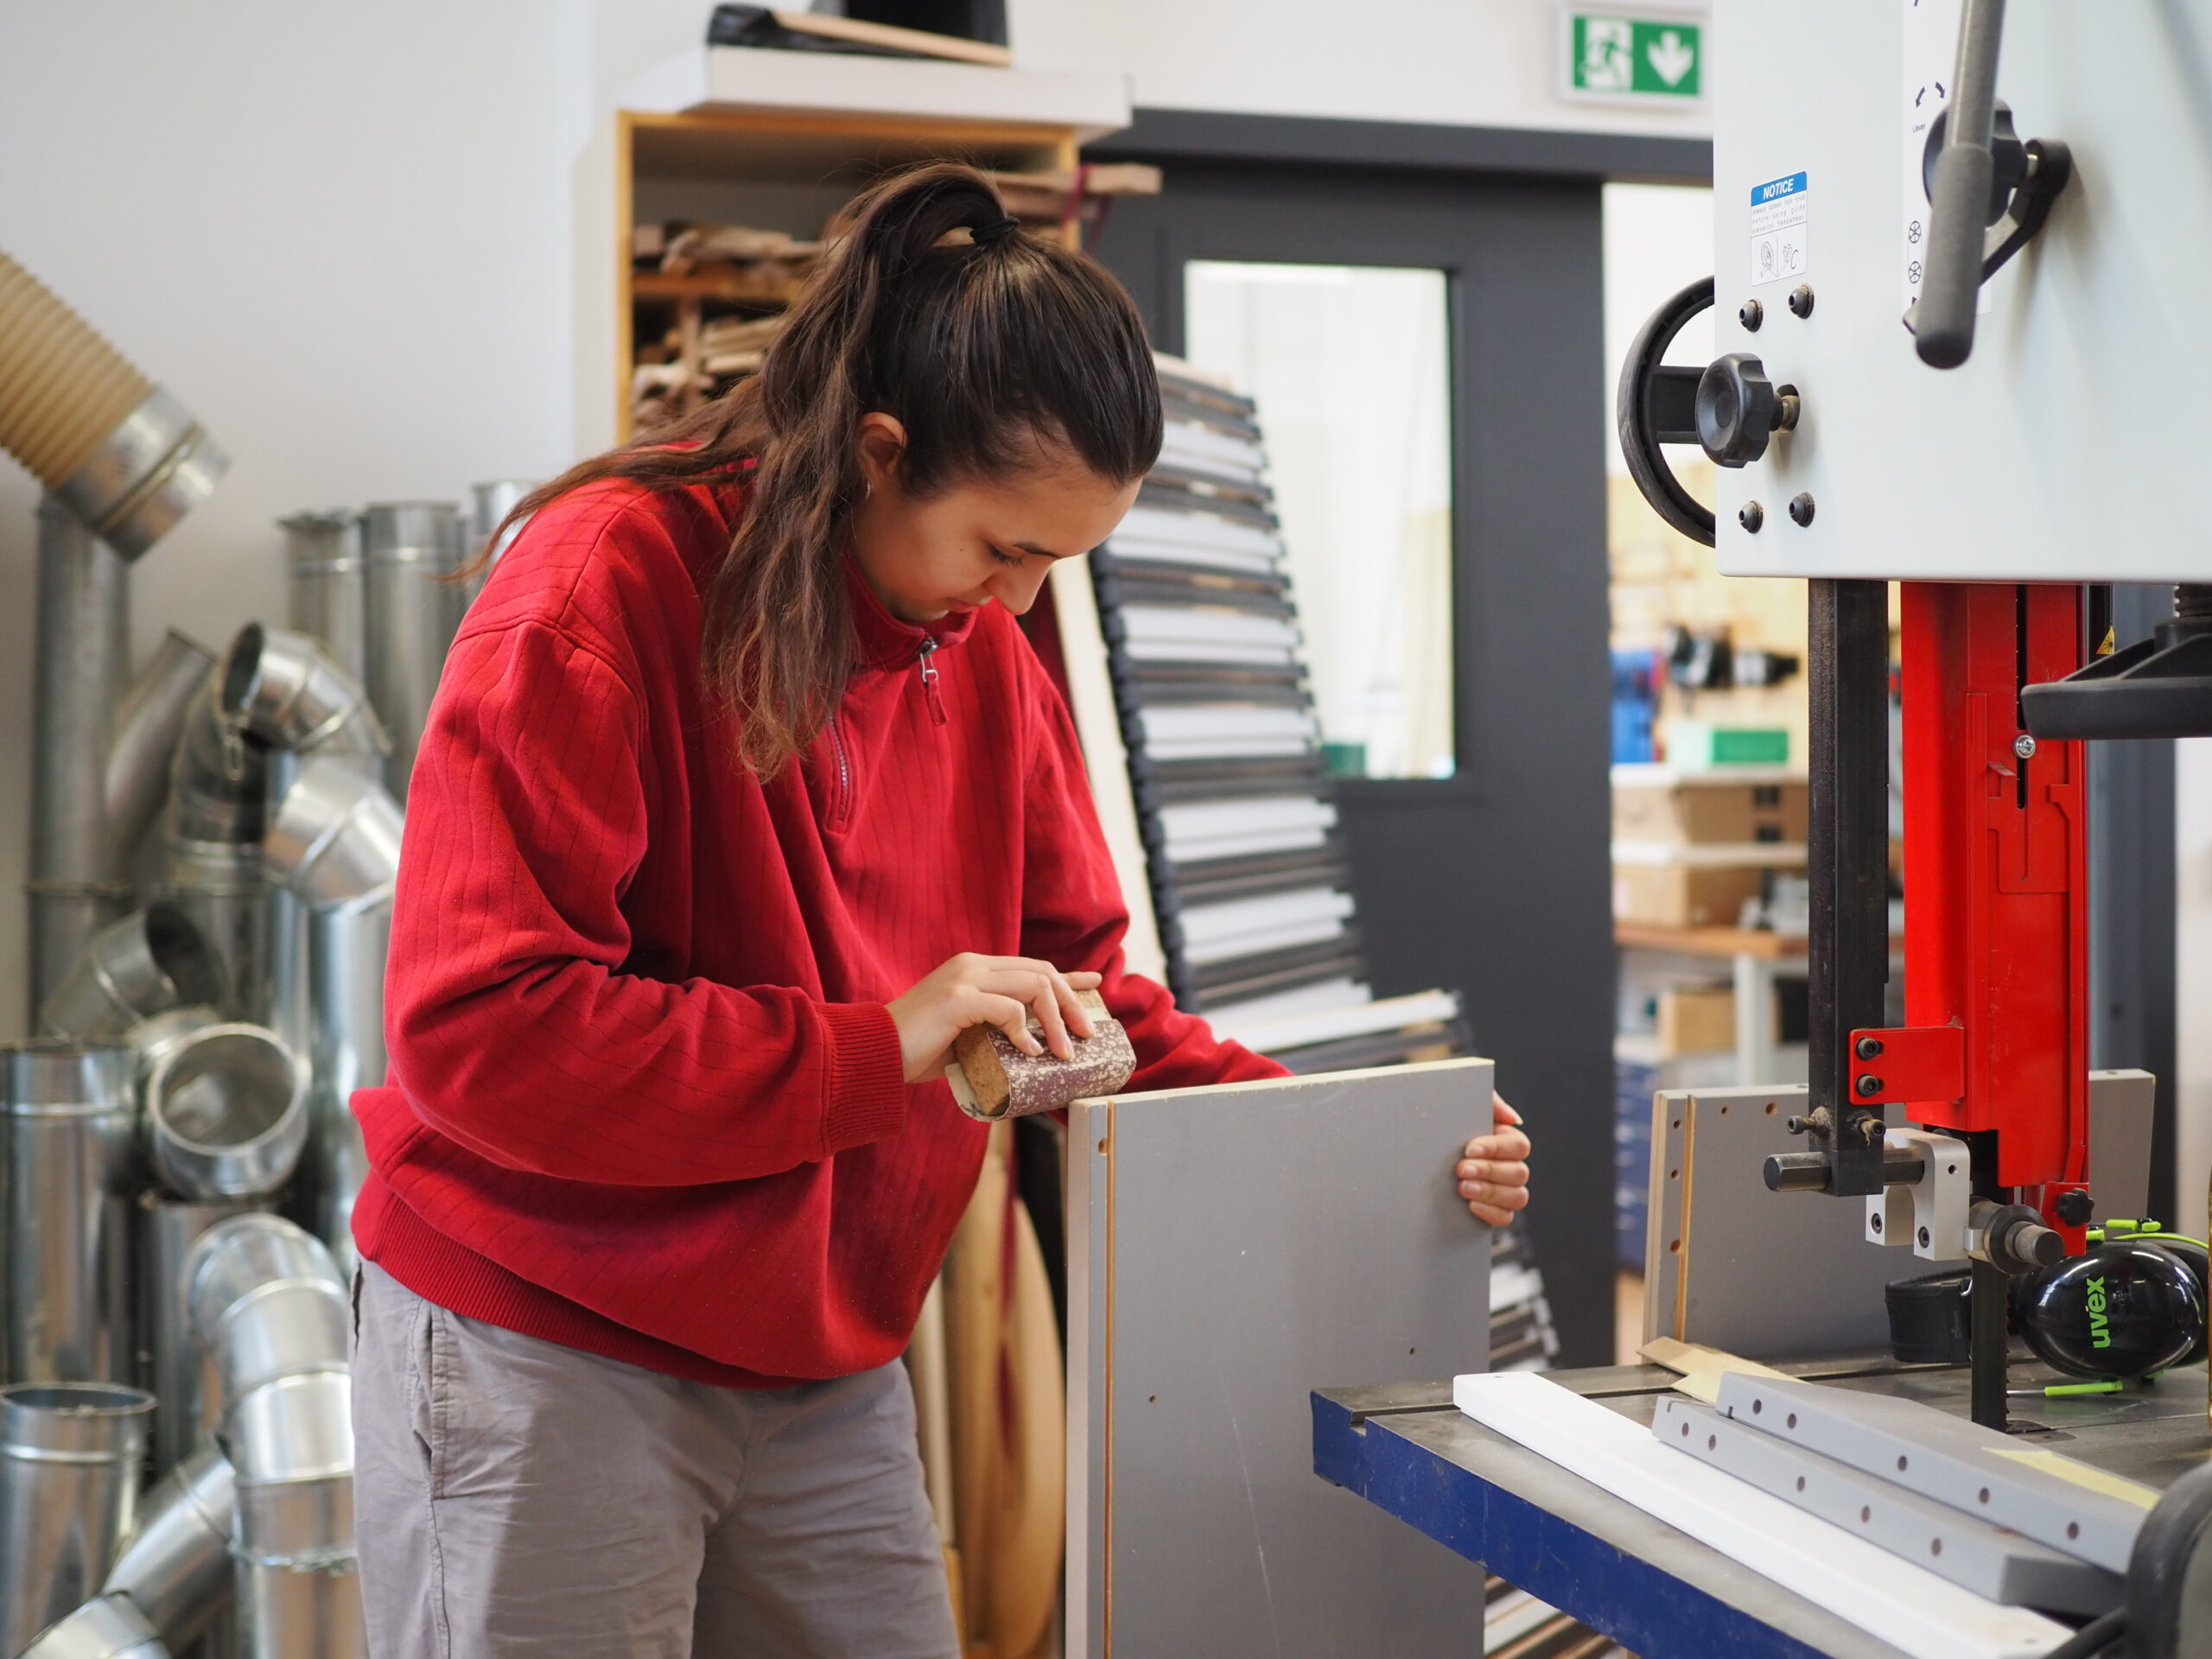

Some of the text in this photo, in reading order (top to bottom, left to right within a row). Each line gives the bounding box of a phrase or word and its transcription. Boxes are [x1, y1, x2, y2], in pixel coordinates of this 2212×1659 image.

[1763, 178, 1795, 200] NOTICE
[1752, 204, 1805, 225] before using guide
[2086, 1275, 2111, 1349] uvex
